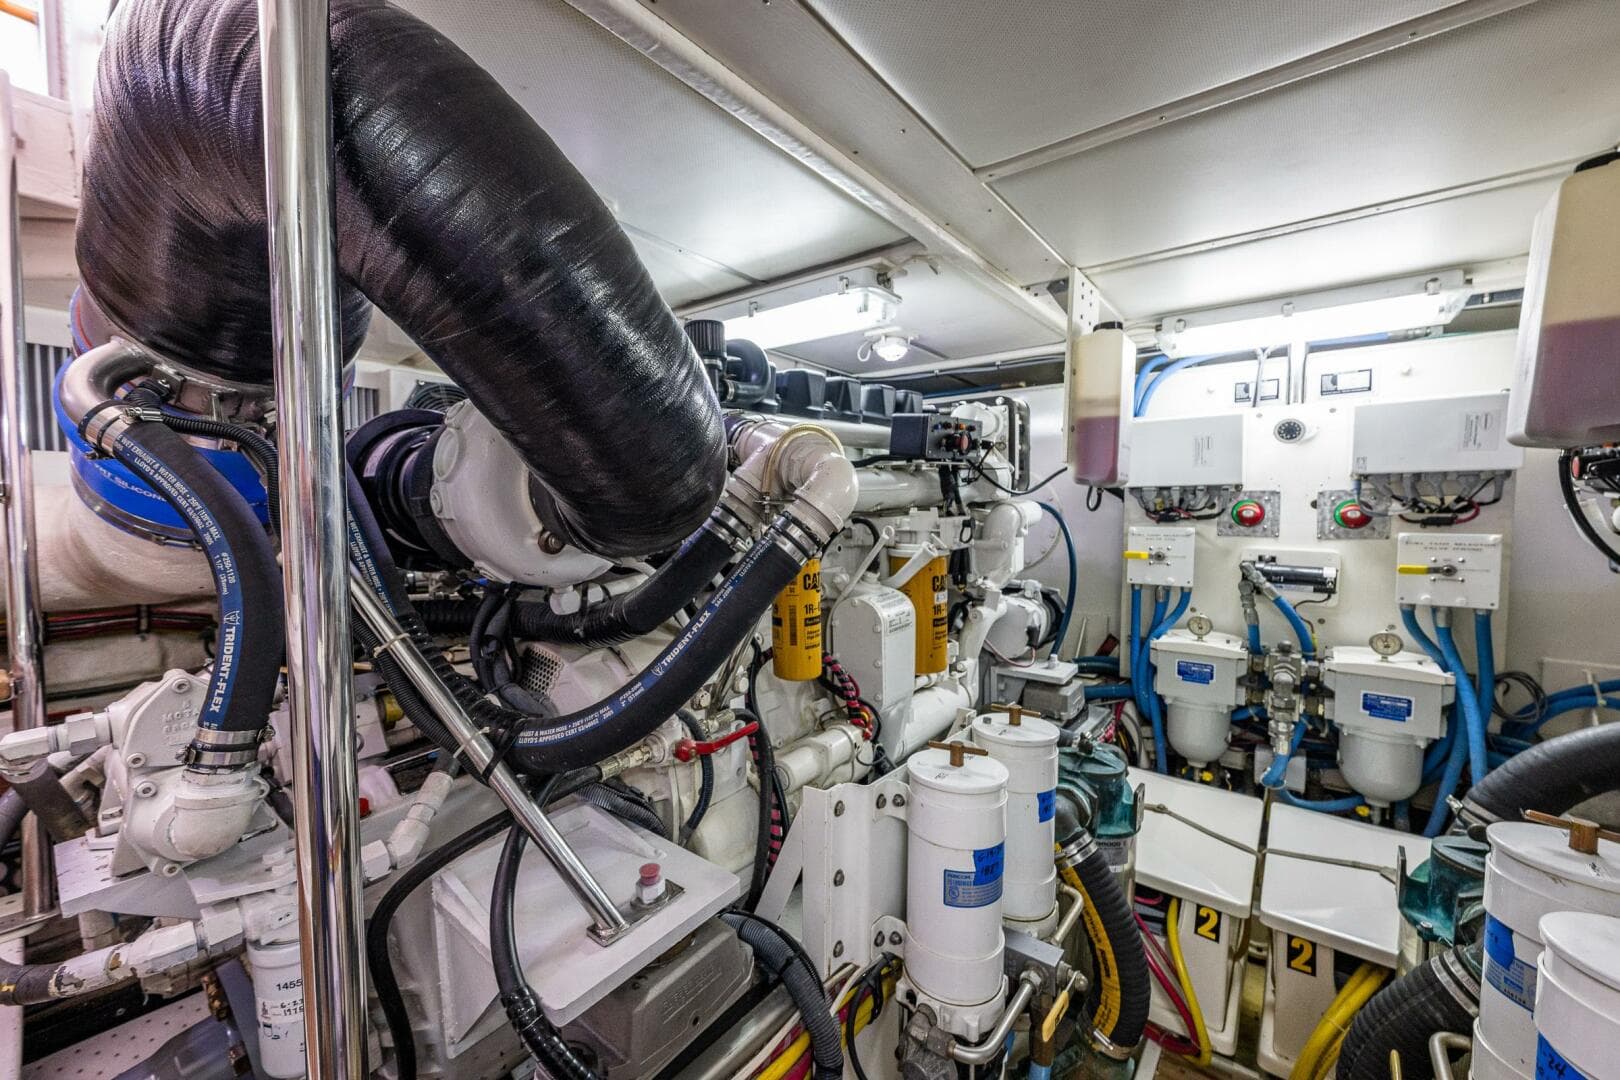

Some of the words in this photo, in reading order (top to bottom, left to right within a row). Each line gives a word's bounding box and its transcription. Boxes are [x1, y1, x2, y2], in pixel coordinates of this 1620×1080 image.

[158, 464, 178, 484] WATER
[662, 610, 712, 667] TRIDENT-FLEX
[210, 626, 236, 712] TRIDENT-FLEX
[1197, 906, 1218, 940] 2
[1290, 937, 1313, 974] 2
